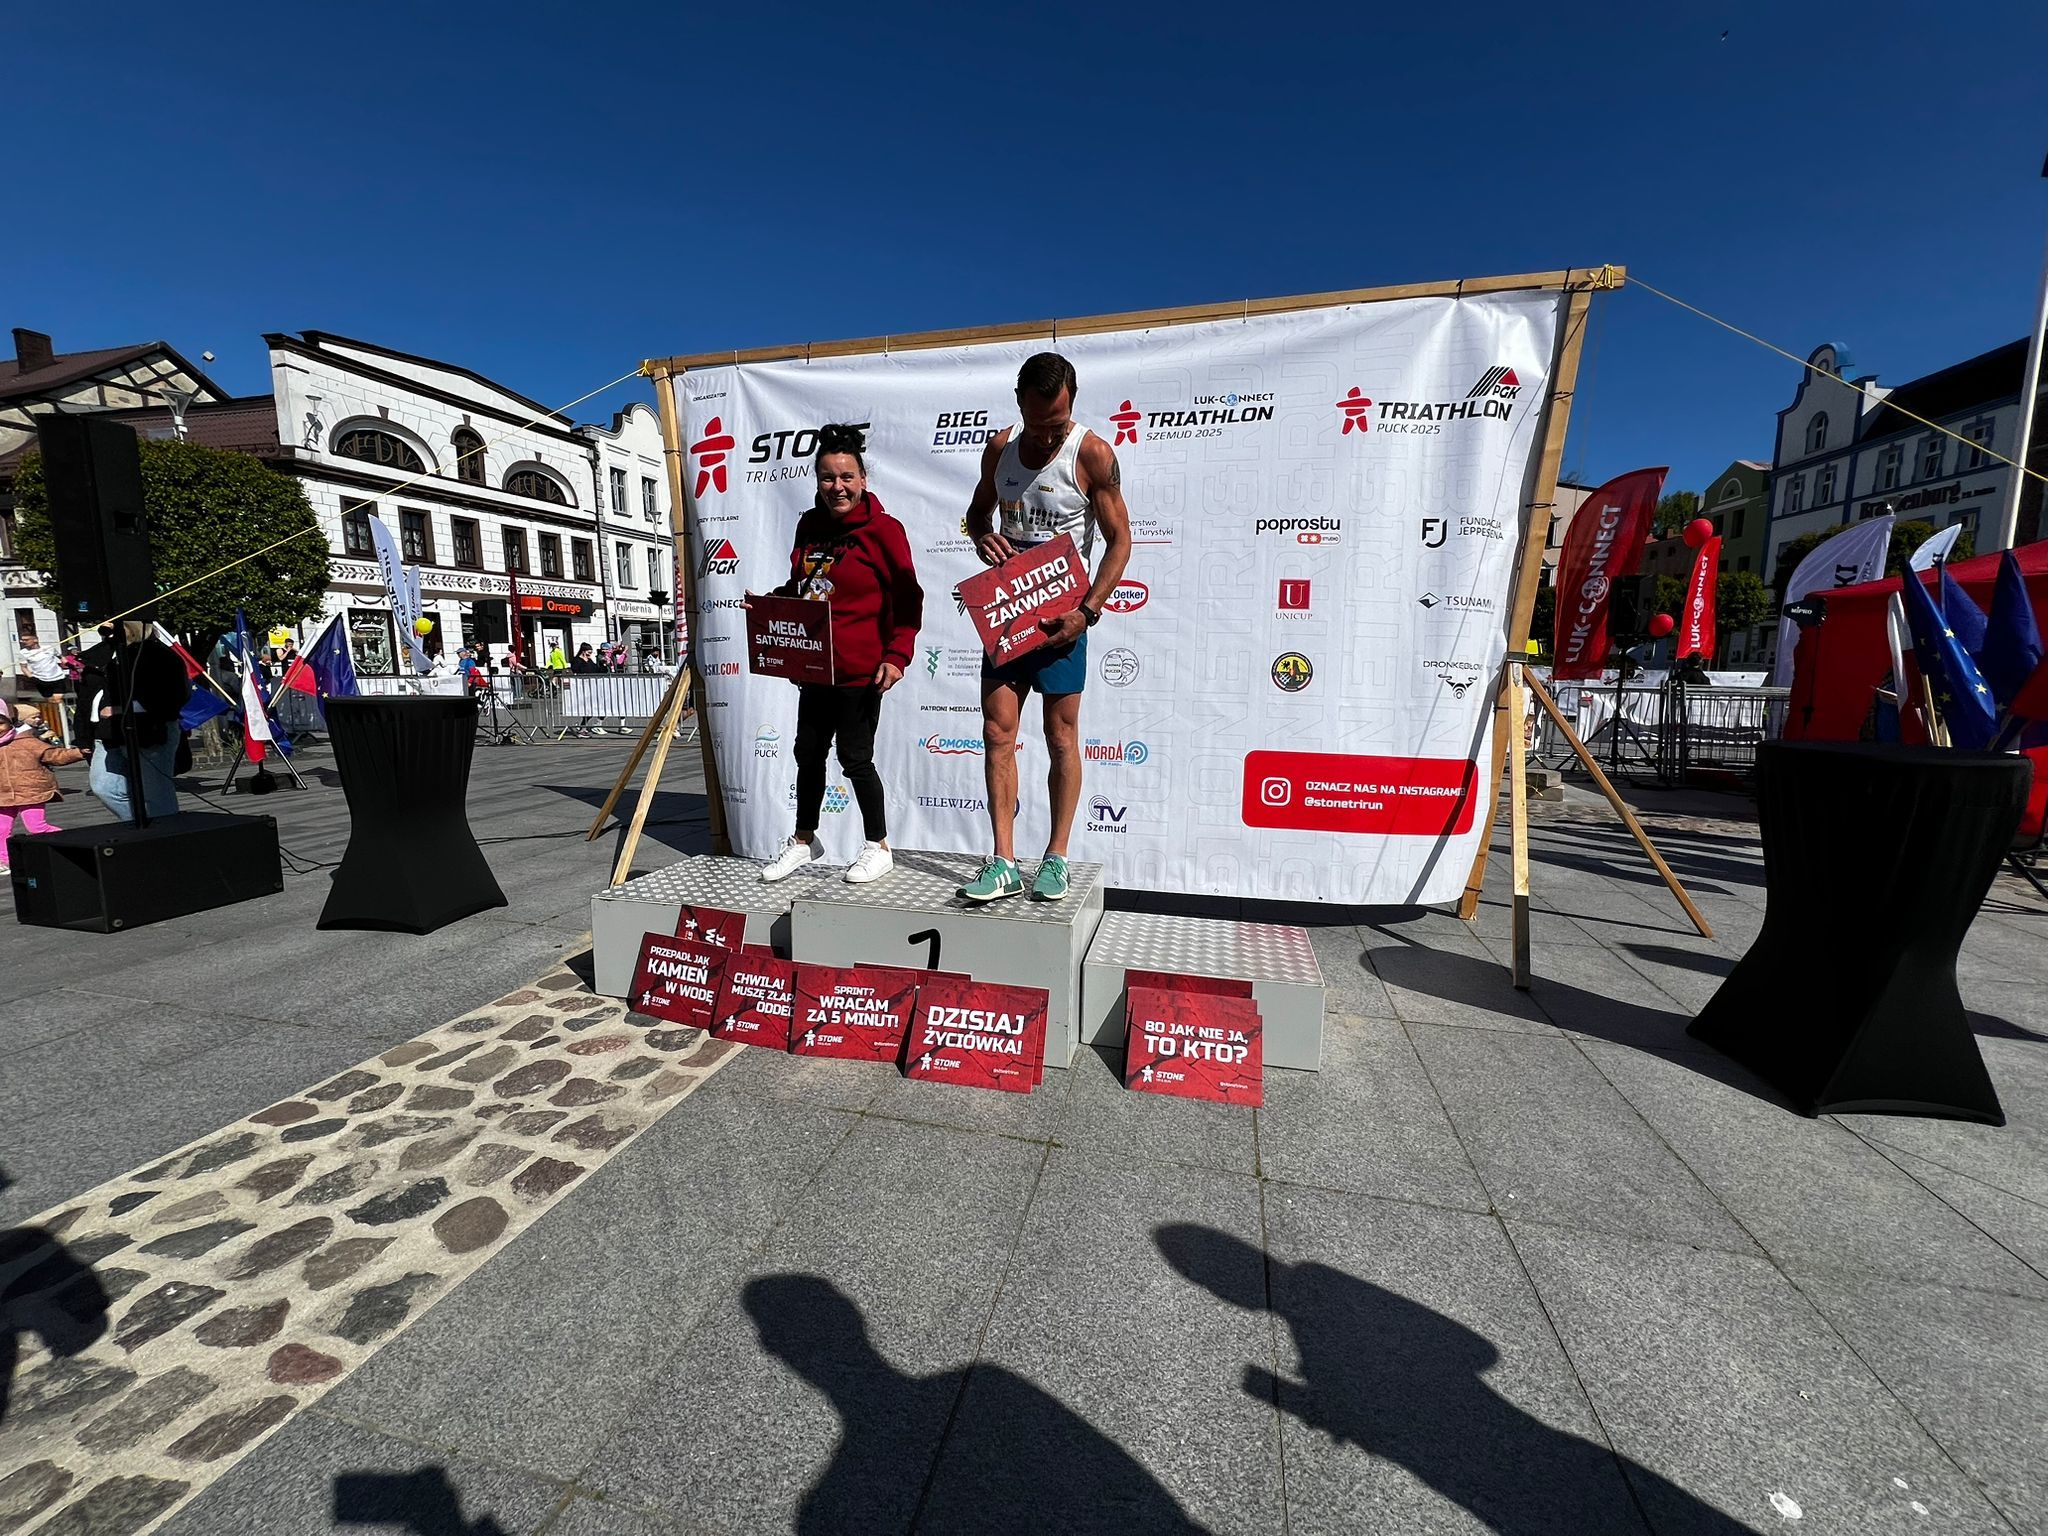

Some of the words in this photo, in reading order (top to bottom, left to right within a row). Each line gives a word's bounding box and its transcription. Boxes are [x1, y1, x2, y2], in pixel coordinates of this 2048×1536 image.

[1491, 385, 1522, 399] PGK
[1147, 406, 1274, 428] TRIATHLON
[1378, 400, 1513, 421] TRIATHLON
[936, 410, 988, 429] BIEG
[1146, 430, 1192, 442] SZEMUD
[1195, 428, 1223, 438] 2025
[1377, 423, 1408, 433] PUCK
[1410, 424, 1441, 434] 2025
[748, 422, 871, 464] STOE
[933, 429, 1003, 446] EUROP
[746, 471, 767, 483] TRI
[769, 468, 778, 482] &
[780, 465, 810, 480] RUN
[1256, 516, 1341, 534] poprostu
[1460, 517, 1502, 530] FUNDACJA
[1139, 528, 1173, 537] Turystyki
[1457, 526, 1504, 540] JEPPESENA
[707, 559, 740, 576] PGK
[1010, 555, 1070, 597] JUTRO
[547, 601, 581, 614] Orange
[985, 573, 1078, 629] ZAKWASY!
[1445, 596, 1492, 607] TSUNAMI
[768, 620, 807, 637] MEGA
[1011, 626, 1037, 643] STONE
[755, 634, 823, 651] SATYSFAKCJA!
[766, 657, 784, 666] STONE
[754, 750, 778, 758] PUCK
[1084, 740, 1123, 760] NORDA
[1306, 781, 1351, 793] OZNACZ
[1354, 783, 1377, 793] NAS
[1380, 785, 1396, 795] NA
[918, 796, 985, 812] TELEWIZJA
[1304, 797, 1383, 810] @stonetrirun
[1094, 805, 1127, 822] TV
[1087, 822, 1127, 833] Szemud
[650, 946, 693, 963] PRZEPADŁ
[693, 954, 710, 966] JAK
[647, 958, 708, 985] KAMIEŃ
[733, 972, 785, 990] CHWILA!
[665, 981, 678, 994] W
[679, 985, 715, 1005] WODĘ
[731, 985, 766, 1001] MUSZĘ
[834, 985, 875, 997] SPRINT?
[651, 996, 671, 1006] STONE
[819, 995, 889, 1013] WRACAM
[737, 1021, 760, 1031] STONE
[806, 1009, 828, 1023] ZA
[831, 1011, 841, 1024] 5
[844, 1012, 899, 1028] MINUT!
[927, 1005, 1025, 1036] DZISIAJ
[817, 1034, 844, 1043] STONE
[1144, 1020, 1166, 1033] BO
[1168, 1023, 1195, 1037] JAK
[1198, 1026, 1224, 1041] NIE
[923, 1026, 1023, 1056] ŻYCIÓWKA!
[1144, 1034, 1177, 1056] TO
[1183, 1039, 1249, 1065] KTO?
[934, 1058, 961, 1069] STONE
[1156, 1071, 1185, 1081] STONE
